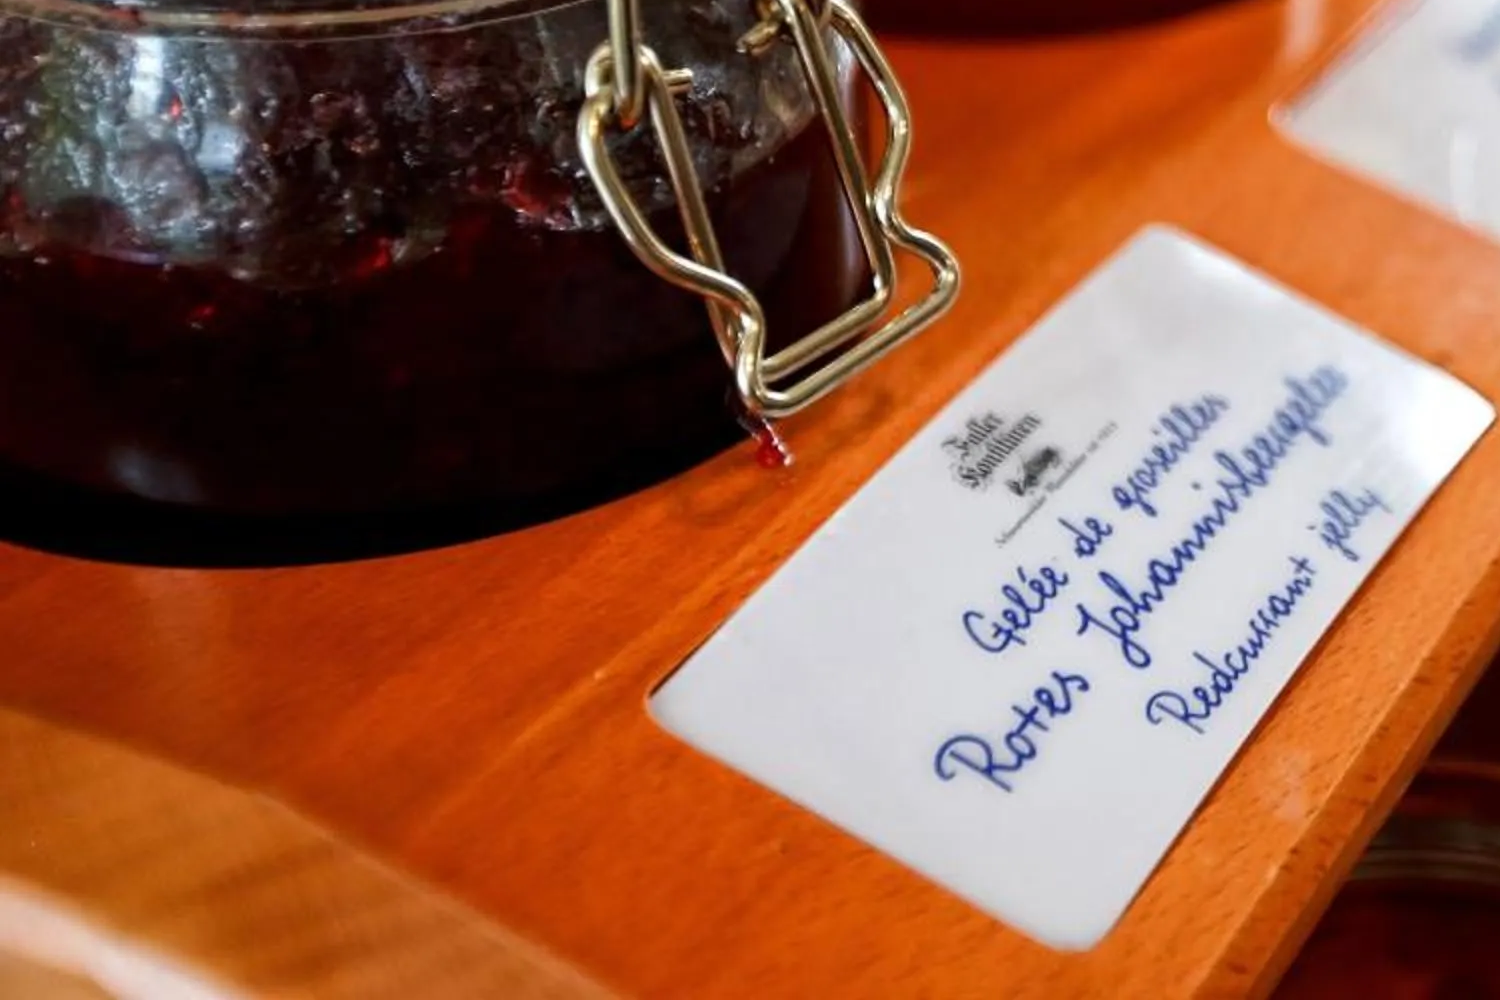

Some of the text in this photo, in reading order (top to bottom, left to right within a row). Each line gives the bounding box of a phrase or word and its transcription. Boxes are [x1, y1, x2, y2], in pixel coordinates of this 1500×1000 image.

[962, 565, 1069, 653] Gelée
[1058, 516, 1113, 558] de
[1111, 394, 1231, 517] groseilles
[1145, 488, 1394, 735] Redcurrant jelly
[933, 671, 1090, 793] Rotes
